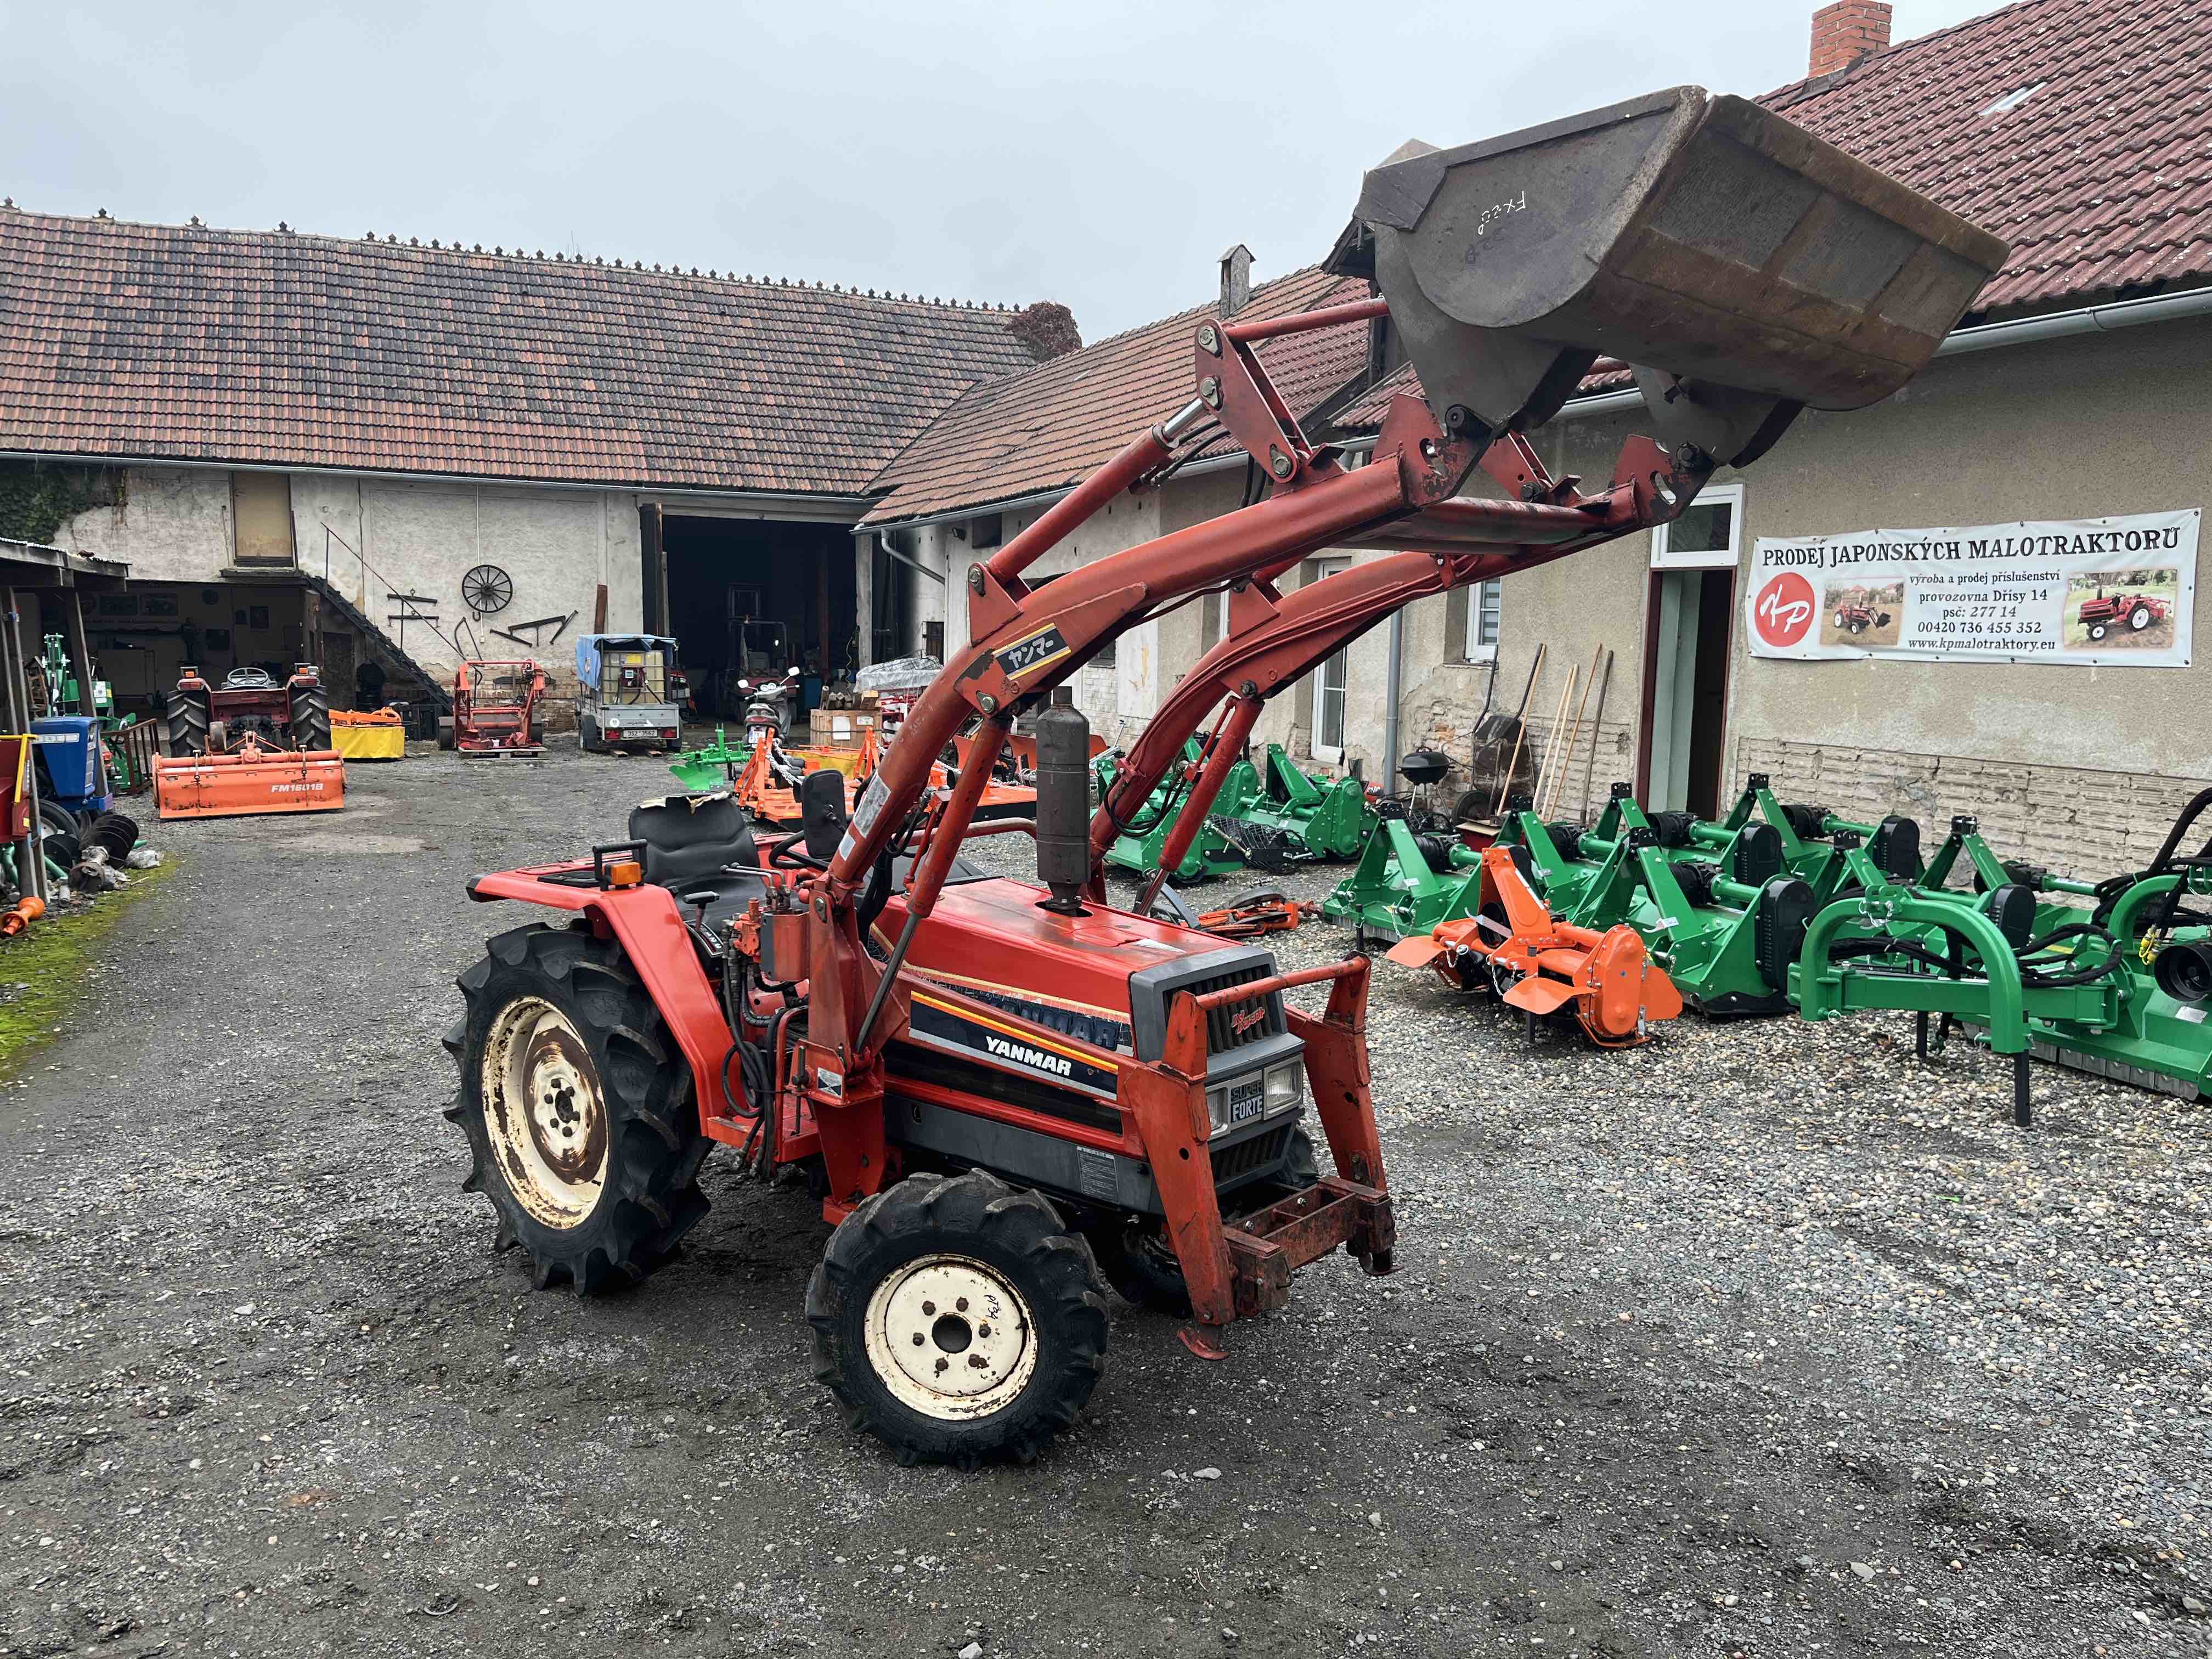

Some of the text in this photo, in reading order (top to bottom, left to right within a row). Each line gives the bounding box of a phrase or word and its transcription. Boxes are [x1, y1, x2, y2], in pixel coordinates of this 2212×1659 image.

[1762, 527, 2180, 568] PRODEJ JAPONSKÝCH MALOTRAKTORŮ
[1910, 573, 1945, 586] výroba
[1957, 572, 1988, 585] prodej
[1991, 569, 2061, 585] příslušenství
[1919, 589, 2048, 605] provozovna Dřísy 14
[1943, 605, 2017, 620] psč: 277 14
[1917, 622, 2042, 634] 00420 736 455 352
[1008, 636, 1054, 669] ヤンマー
[1908, 636, 2056, 652] www.kpmalotraktory.eu
[986, 1035, 1072, 1077] YANMAR
[1232, 1079, 1263, 1099] SUPER
[1233, 1096, 1263, 1122] FORTE
